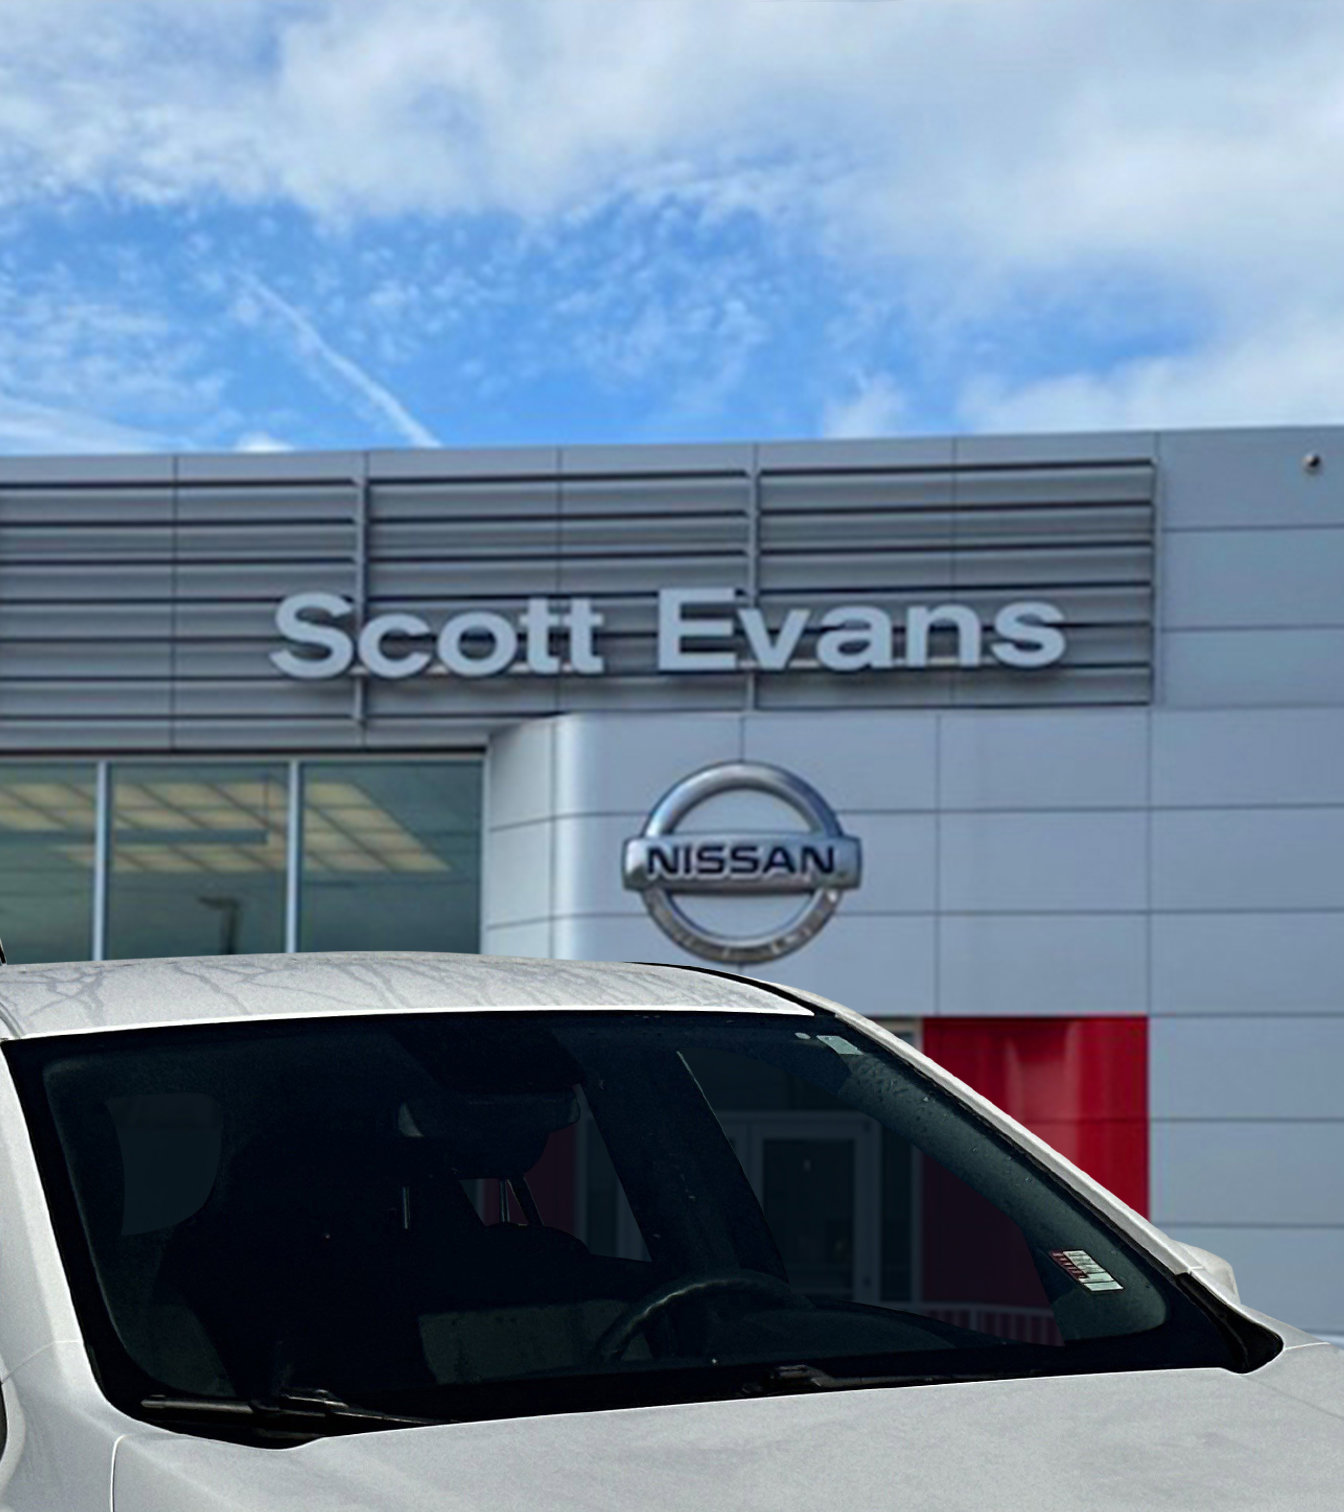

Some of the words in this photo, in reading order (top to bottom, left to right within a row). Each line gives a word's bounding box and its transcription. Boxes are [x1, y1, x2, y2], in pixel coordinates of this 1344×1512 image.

[269, 592, 605, 679] Scott
[657, 586, 1069, 672] Evans
[647, 845, 835, 875] NISSAN
